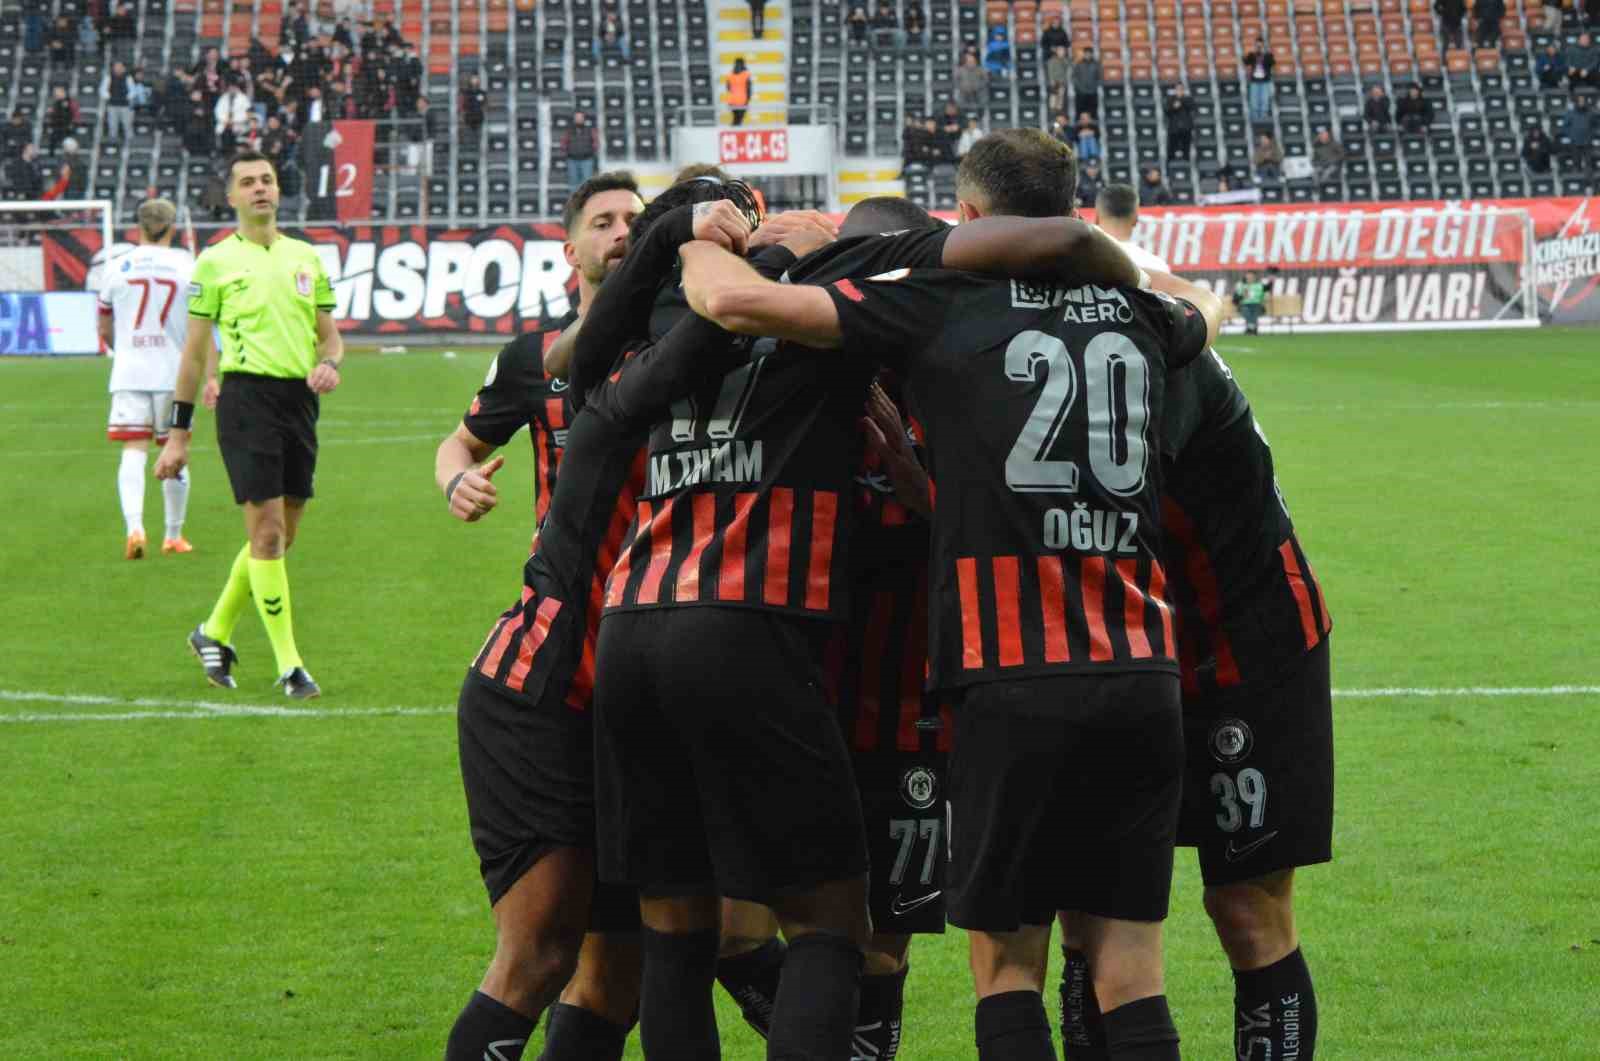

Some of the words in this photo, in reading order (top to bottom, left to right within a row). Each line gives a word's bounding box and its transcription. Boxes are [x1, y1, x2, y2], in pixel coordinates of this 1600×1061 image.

[1218, 208, 1362, 264] TAKIM
[1373, 200, 1501, 260] DEĞİL
[127, 277, 178, 330] 77
[1063, 303, 1134, 324] AERO
[1396, 271, 1487, 321] VAR!
[1004, 329, 1150, 497] 20
[1043, 501, 1139, 553] OĞUZ
[1210, 767, 1268, 833] 39
[889, 818, 941, 886] 77
